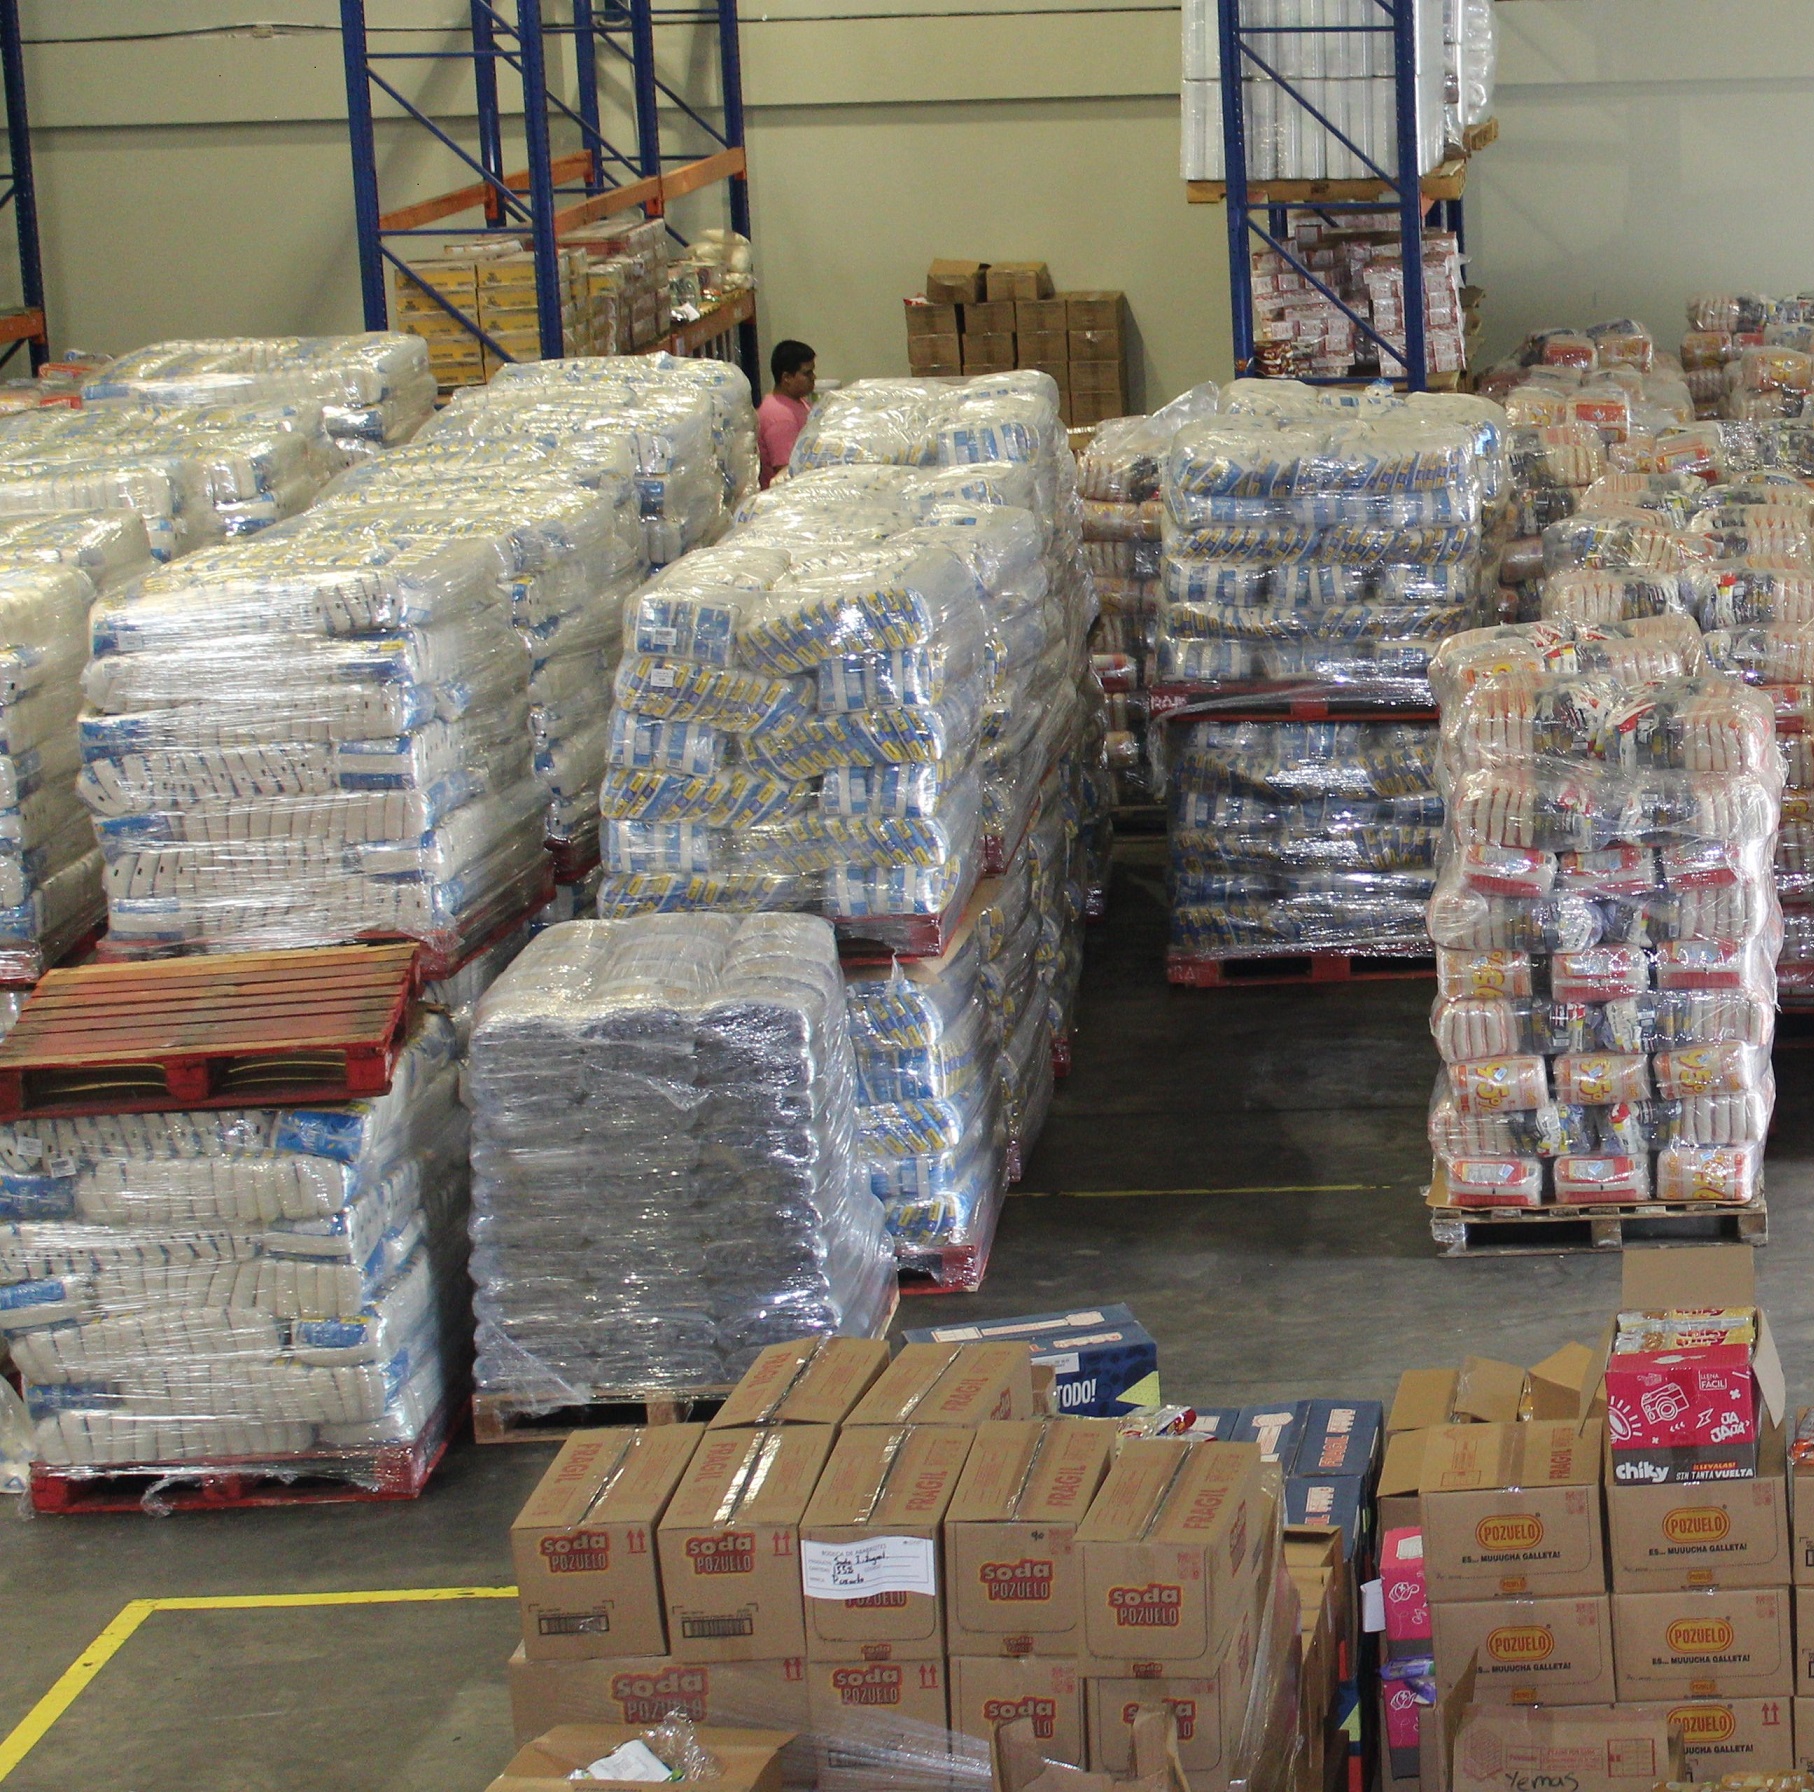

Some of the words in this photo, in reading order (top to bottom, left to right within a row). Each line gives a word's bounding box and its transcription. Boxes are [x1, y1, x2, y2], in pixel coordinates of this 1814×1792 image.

[1715, 1466, 1753, 1478] VUELTA
[1484, 1523, 1536, 1541] POZUELO
[1671, 1517, 1722, 1534] POZUELO
[543, 1532, 606, 1554] soda
[689, 1534, 753, 1556] soda
[551, 1553, 607, 1572] POZUELO
[697, 1556, 751, 1573] POZUELO
[984, 1561, 1050, 1581] soda
[991, 1581, 1050, 1598] POZUELO
[1111, 1586, 1179, 1606] soda
[1119, 1606, 1178, 1625] POZUELO
[1495, 1636, 1546, 1653] POZUELO
[1674, 1628, 1725, 1643] POZUELO
[616, 1670, 704, 1698] soda
[837, 1669, 899, 1686] soda
[842, 1687, 898, 1704] POZUELO
[987, 1699, 1053, 1718] soda
